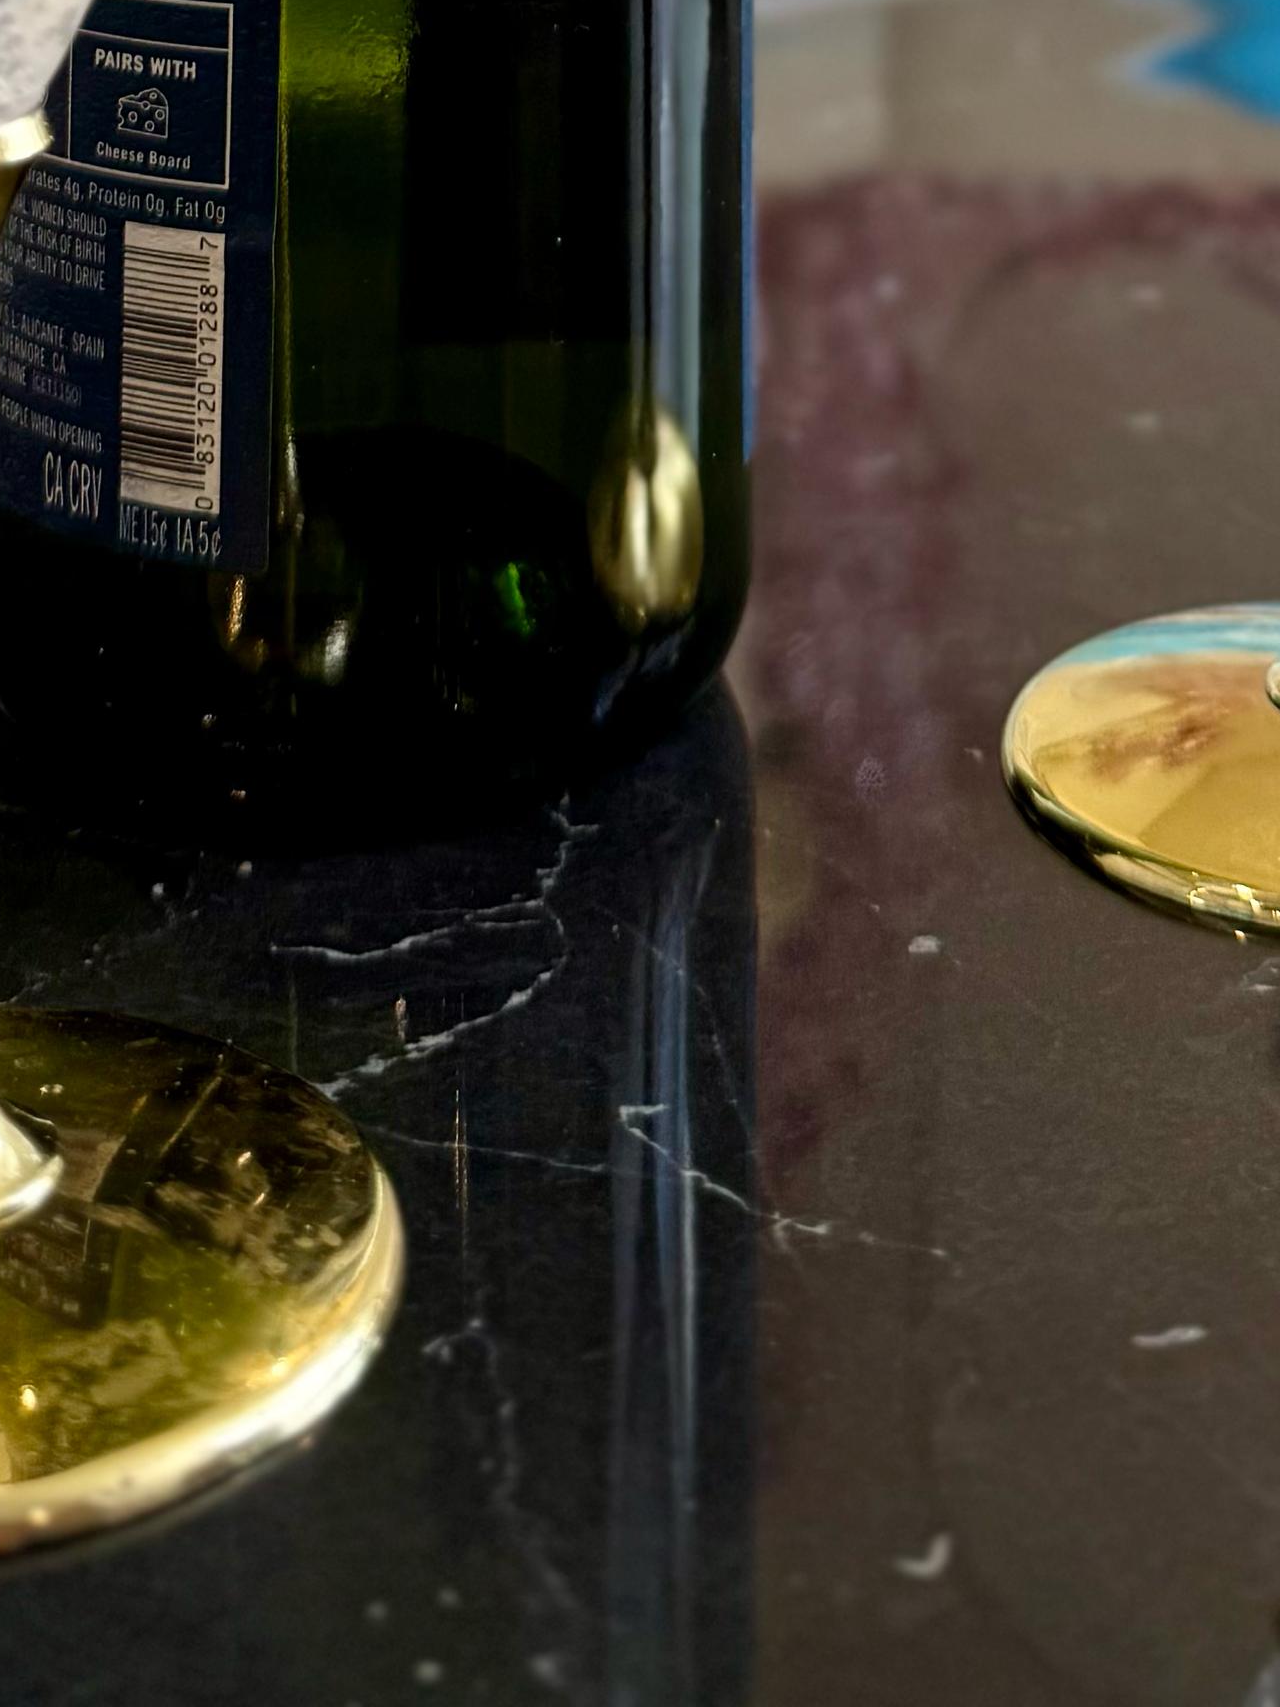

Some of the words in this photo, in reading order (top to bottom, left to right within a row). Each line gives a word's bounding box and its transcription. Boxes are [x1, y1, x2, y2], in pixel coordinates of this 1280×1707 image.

[95, 48, 144, 73] PAIRS
[150, 56, 197, 80] WITH
[96, 141, 144, 163] Cheese
[149, 151, 191, 170] Board
[31, 198, 64, 227] WOMEN
[66, 209, 107, 237] SHOULD
[88, 181, 140, 210] Protein
[176, 197, 203, 218] Fat
[205, 200, 226, 224] 0g
[20, 218, 34, 243] THE
[37, 227, 58, 250] RISK
[60, 233, 73, 255] OF
[75, 237, 107, 265] BIRTH
[25, 249, 59, 278] ABILITY
[60, 260, 73, 283] TO
[75, 263, 107, 292] DRIVE
[72, 330, 105, 361] SPAIN
[30, 409, 57, 440] WHEN
[45, 451, 64, 507] CA
[69, 459, 103, 520] CRV
[119, 503, 139, 543] ME
[177, 516, 194, 553] IA
